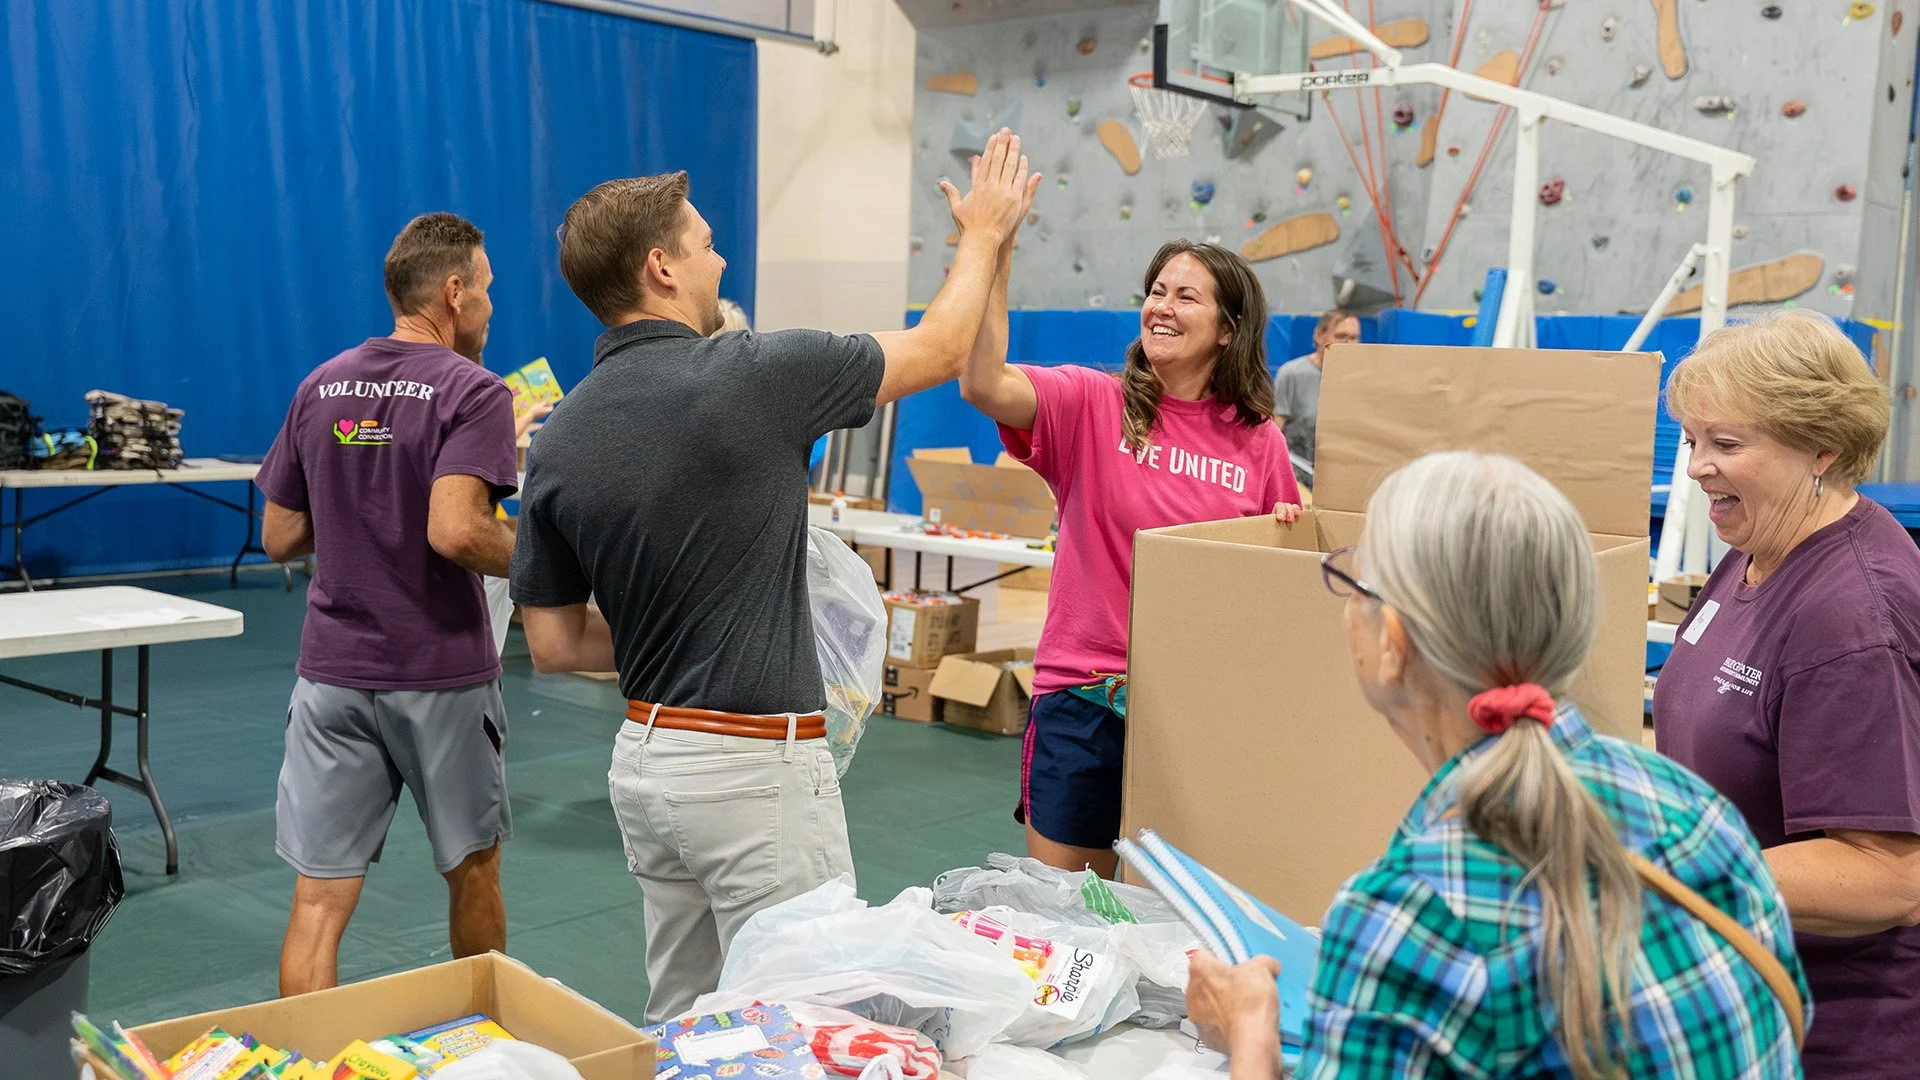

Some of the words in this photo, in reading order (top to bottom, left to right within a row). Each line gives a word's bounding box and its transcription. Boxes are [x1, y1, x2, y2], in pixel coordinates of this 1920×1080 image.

[318, 380, 434, 400] VOLUNTEER
[1118, 437, 1163, 470] LVE
[1169, 446, 1247, 493] UNITED
[1060, 947, 1094, 1004] Sharpie
[348, 1052, 390, 1078] Crayola
[717, 1063, 745, 1075] ZAP
